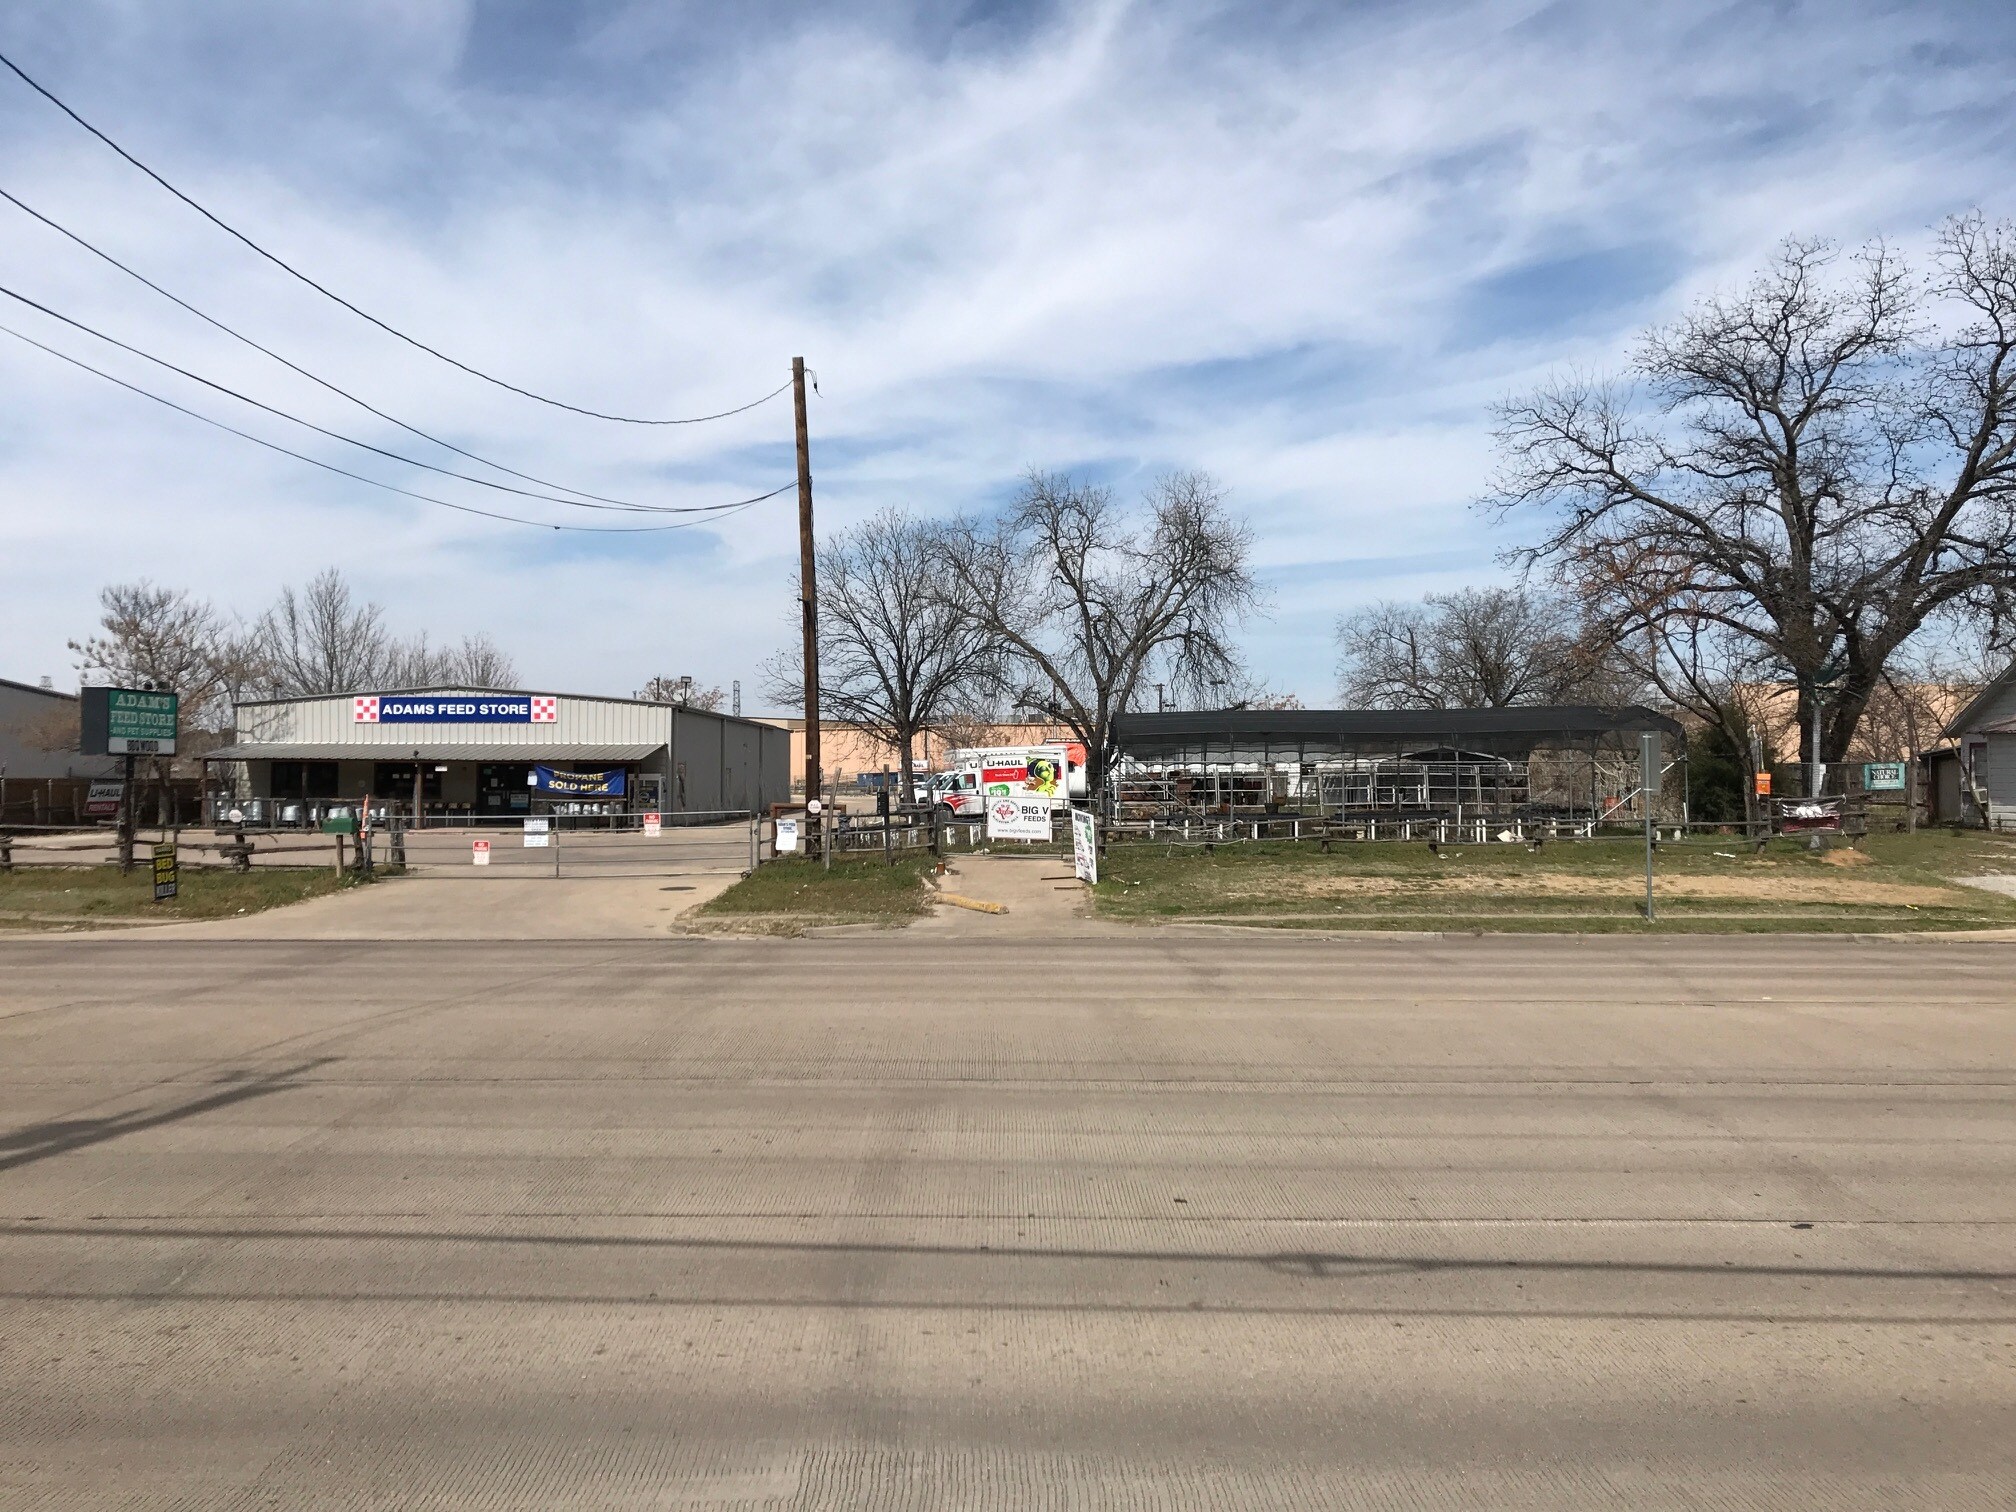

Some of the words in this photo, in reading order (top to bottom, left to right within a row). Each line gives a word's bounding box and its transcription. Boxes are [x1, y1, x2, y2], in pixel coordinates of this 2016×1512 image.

[115, 694, 170, 709] ADAM'S
[382, 704, 435, 715] ADAMS
[438, 704, 476, 715] FEED
[480, 704, 528, 715] STORE
[110, 710, 138, 724] FEED
[139, 712, 174, 726] STORE
[553, 770, 604, 781] PROPANE
[548, 780, 578, 791] SOLD
[580, 782, 609, 792] HERE
[90, 788, 121, 798] U-HAUL
[1021, 805, 1039, 815] BIG
[1042, 806, 1050, 815] V
[156, 857, 174, 870] BED
[156, 870, 175, 884] BUG
